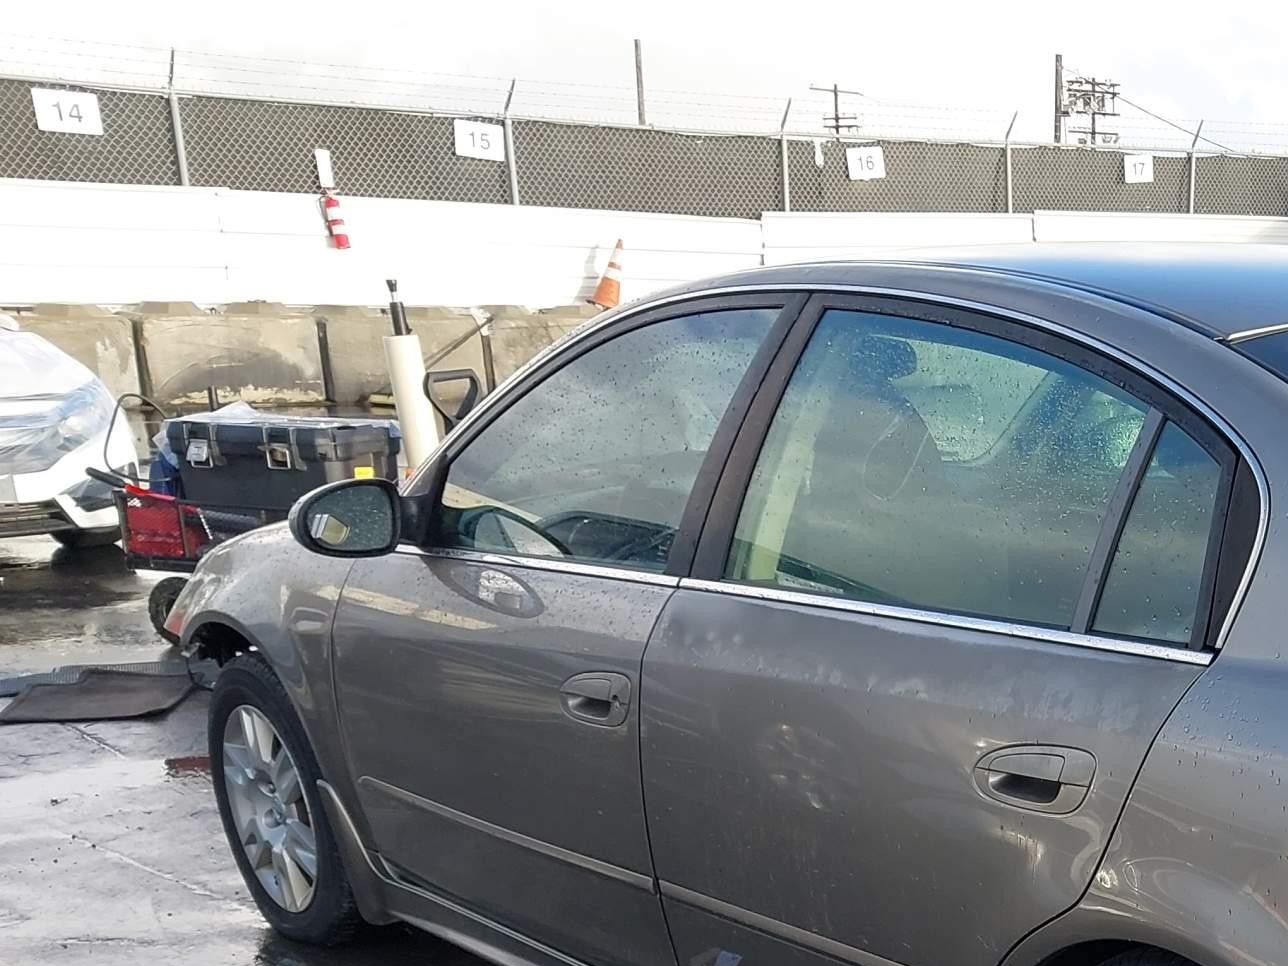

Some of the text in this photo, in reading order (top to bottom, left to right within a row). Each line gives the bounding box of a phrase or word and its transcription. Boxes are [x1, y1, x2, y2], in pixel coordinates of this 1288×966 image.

[51, 101, 83, 123] 14
[469, 131, 491, 151] 15
[857, 155, 875, 171] 16
[1132, 162, 1145, 176] 17
